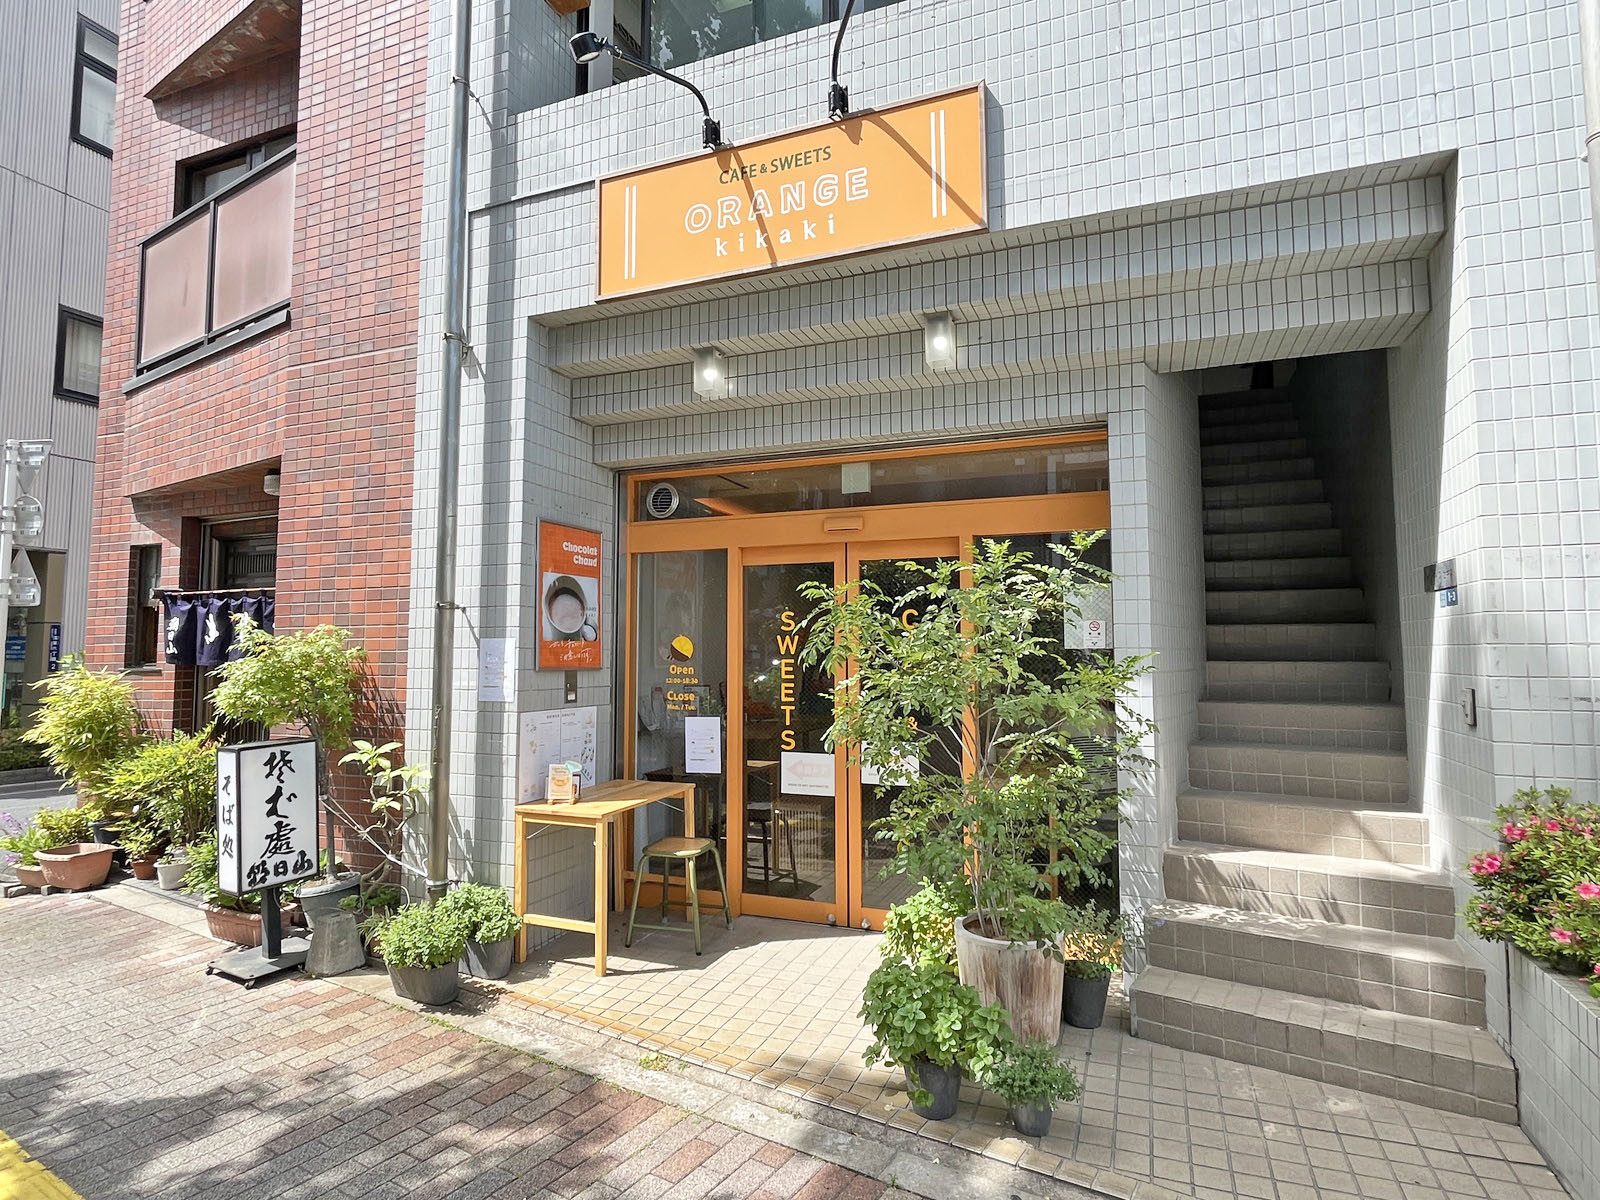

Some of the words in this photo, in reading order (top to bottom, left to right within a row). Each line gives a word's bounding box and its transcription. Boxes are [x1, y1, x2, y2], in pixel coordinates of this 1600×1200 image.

[719, 163, 757, 185] CAFE
[770, 146, 832, 174] SWEETS
[684, 166, 869, 234] ORANGE
[715, 213, 836, 257] kikaki
[562, 541, 598, 556] Chocolat
[573, 554, 598, 567] Chaud
[669, 664, 695, 676] Open
[777, 611, 799, 751] SWEETS
[221, 774, 236, 860] そば処
